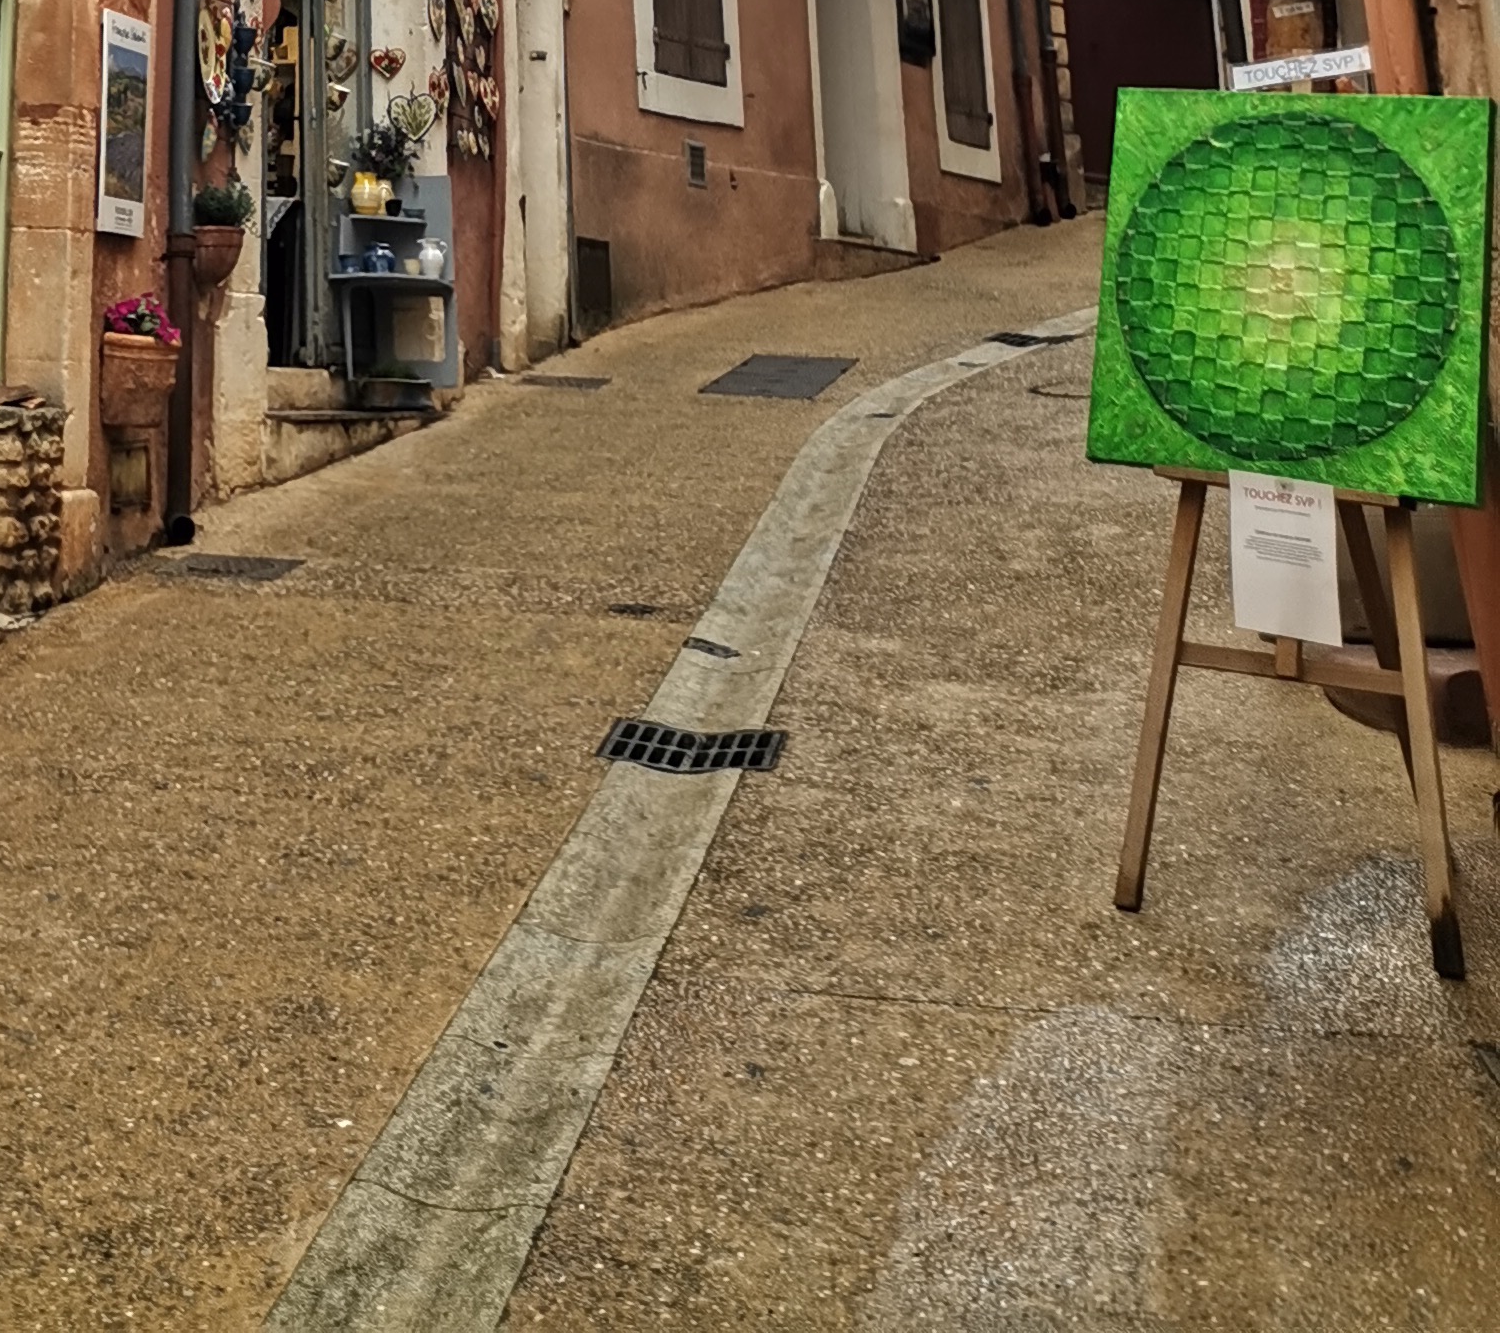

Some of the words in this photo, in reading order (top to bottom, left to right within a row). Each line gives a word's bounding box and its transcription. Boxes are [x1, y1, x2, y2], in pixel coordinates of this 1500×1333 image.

[1244, 58, 1319, 82] TOUCHEZ
[1322, 55, 1354, 72] SVP
[1243, 486, 1293, 506] TOUCHEZ
[1295, 494, 1316, 508] SVP
